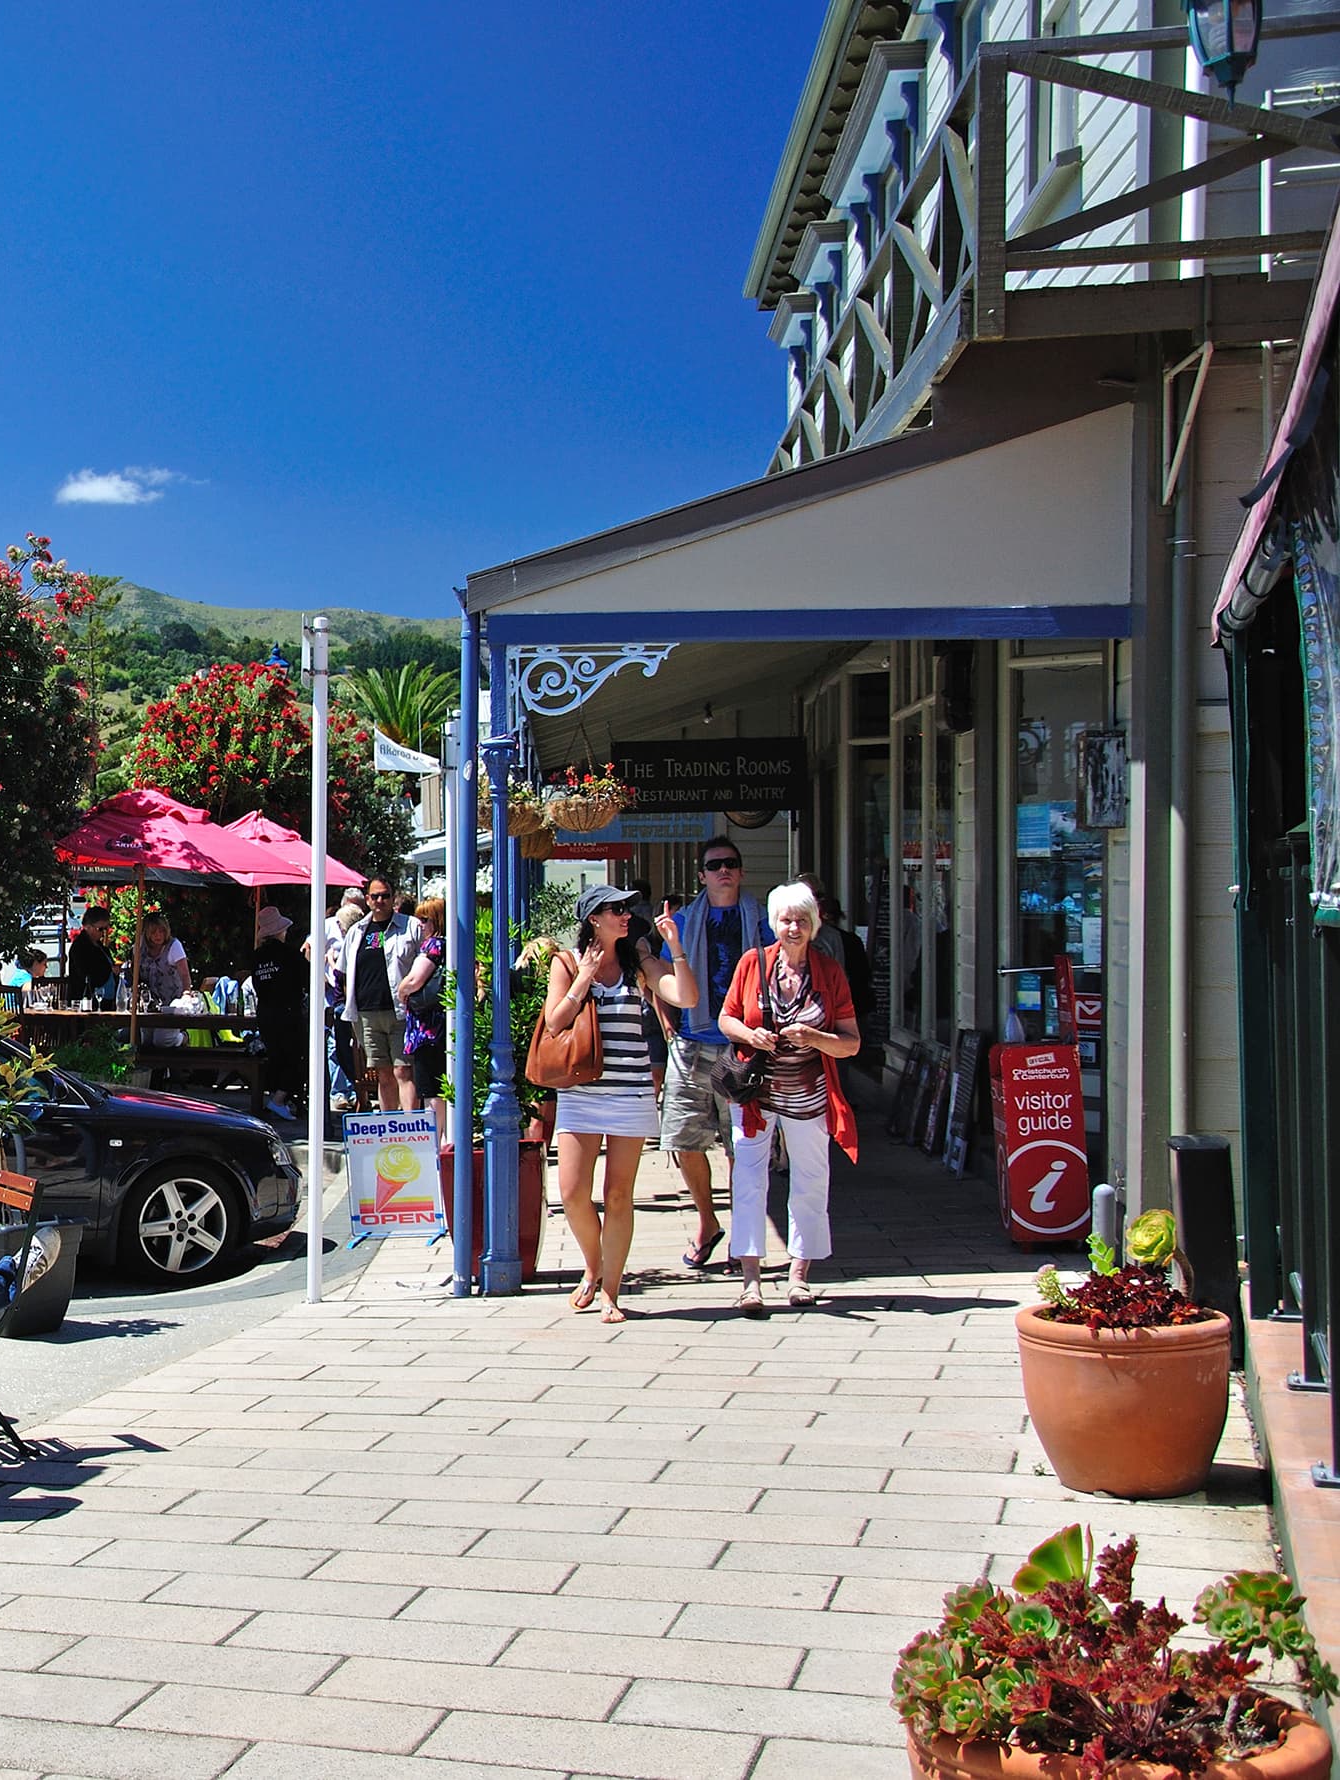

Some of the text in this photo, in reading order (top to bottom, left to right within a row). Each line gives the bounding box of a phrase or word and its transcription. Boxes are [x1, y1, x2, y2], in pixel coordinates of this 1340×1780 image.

[379, 743, 411, 760] Akaroa
[619, 756, 792, 779] THE TRADING ROOMS
[632, 783, 786, 802] RESTAURANT AND PANTRY
[1012, 1067, 1069, 1075] Christchurch
[1021, 1072, 1070, 1081] Canterbury
[1014, 1090, 1073, 1110] visitor
[350, 1119, 430, 1137] Deep South
[1018, 1111, 1072, 1136] guide
[379, 1135, 430, 1144] CREAM
[360, 1212, 436, 1225] OPEN
